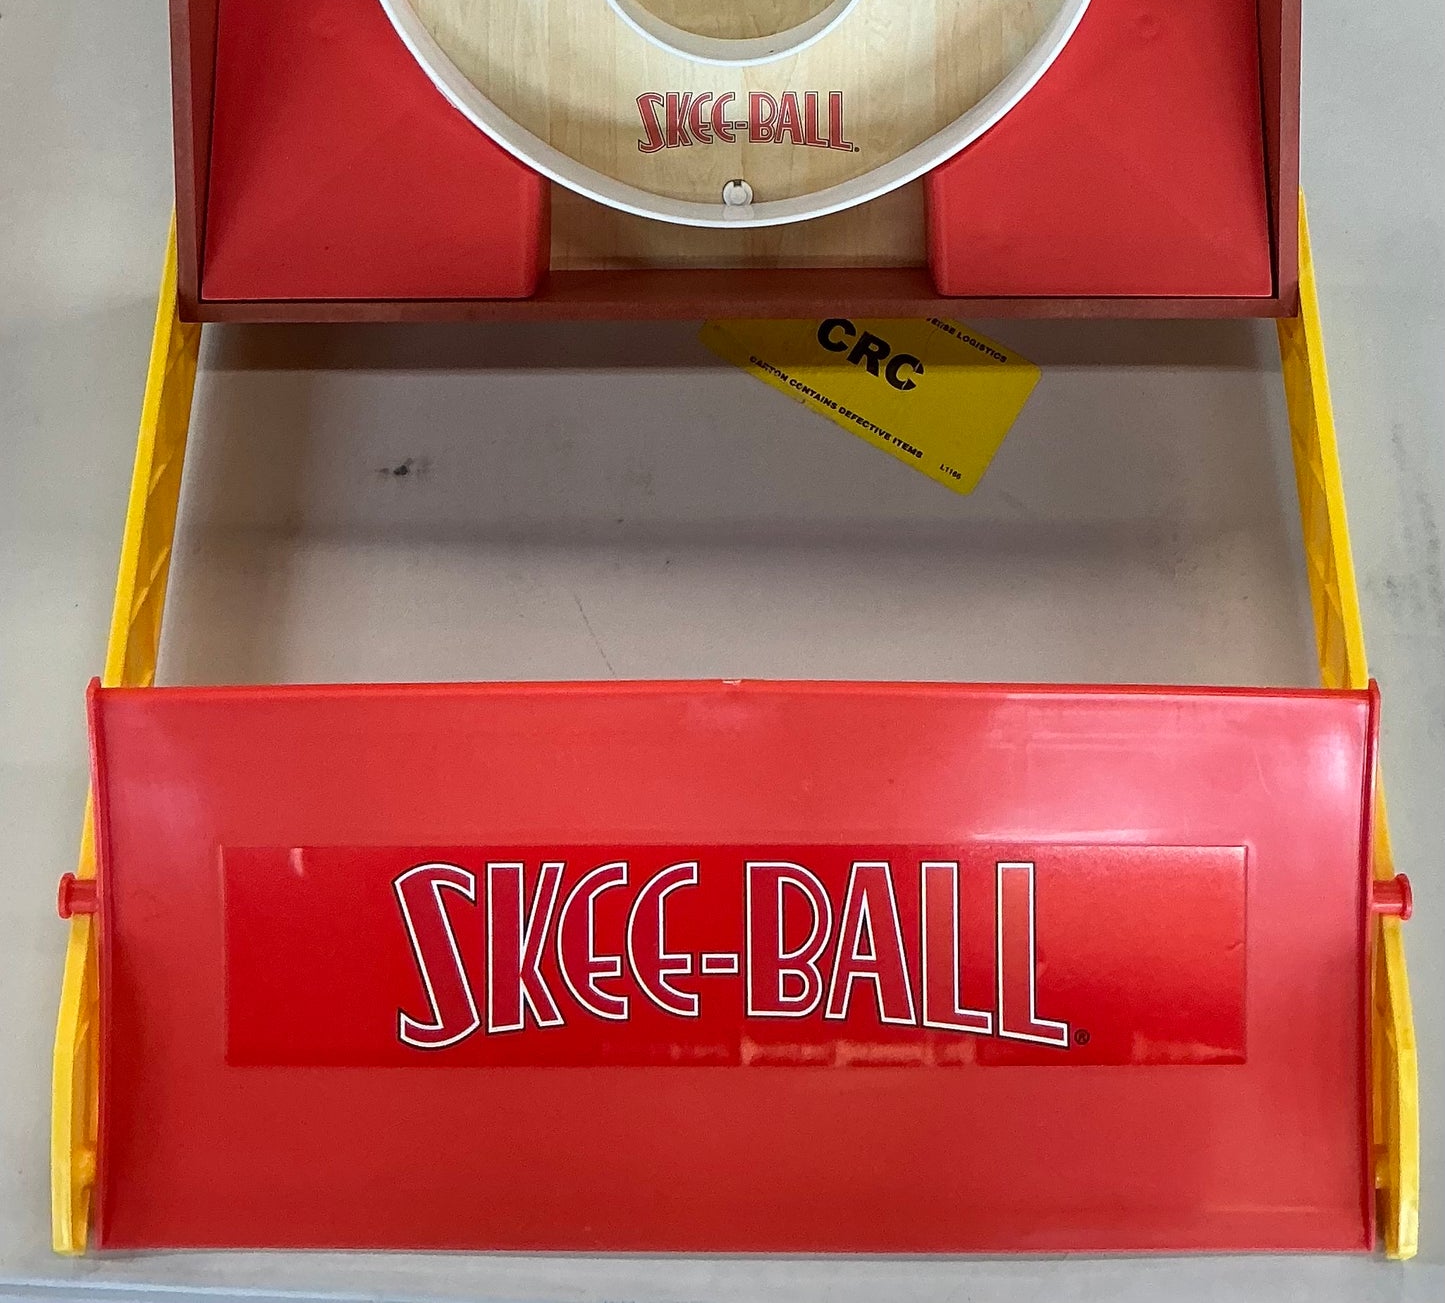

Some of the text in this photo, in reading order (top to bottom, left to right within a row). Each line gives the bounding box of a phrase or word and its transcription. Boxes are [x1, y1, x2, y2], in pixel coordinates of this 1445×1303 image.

[636, 91, 854, 153] SKEE-BALL
[816, 318, 925, 391] CRC
[956, 331, 1008, 363] LOGISTICS
[749, 355, 924, 459] CARTON CONTAINS DEFECTIVE ITEMS
